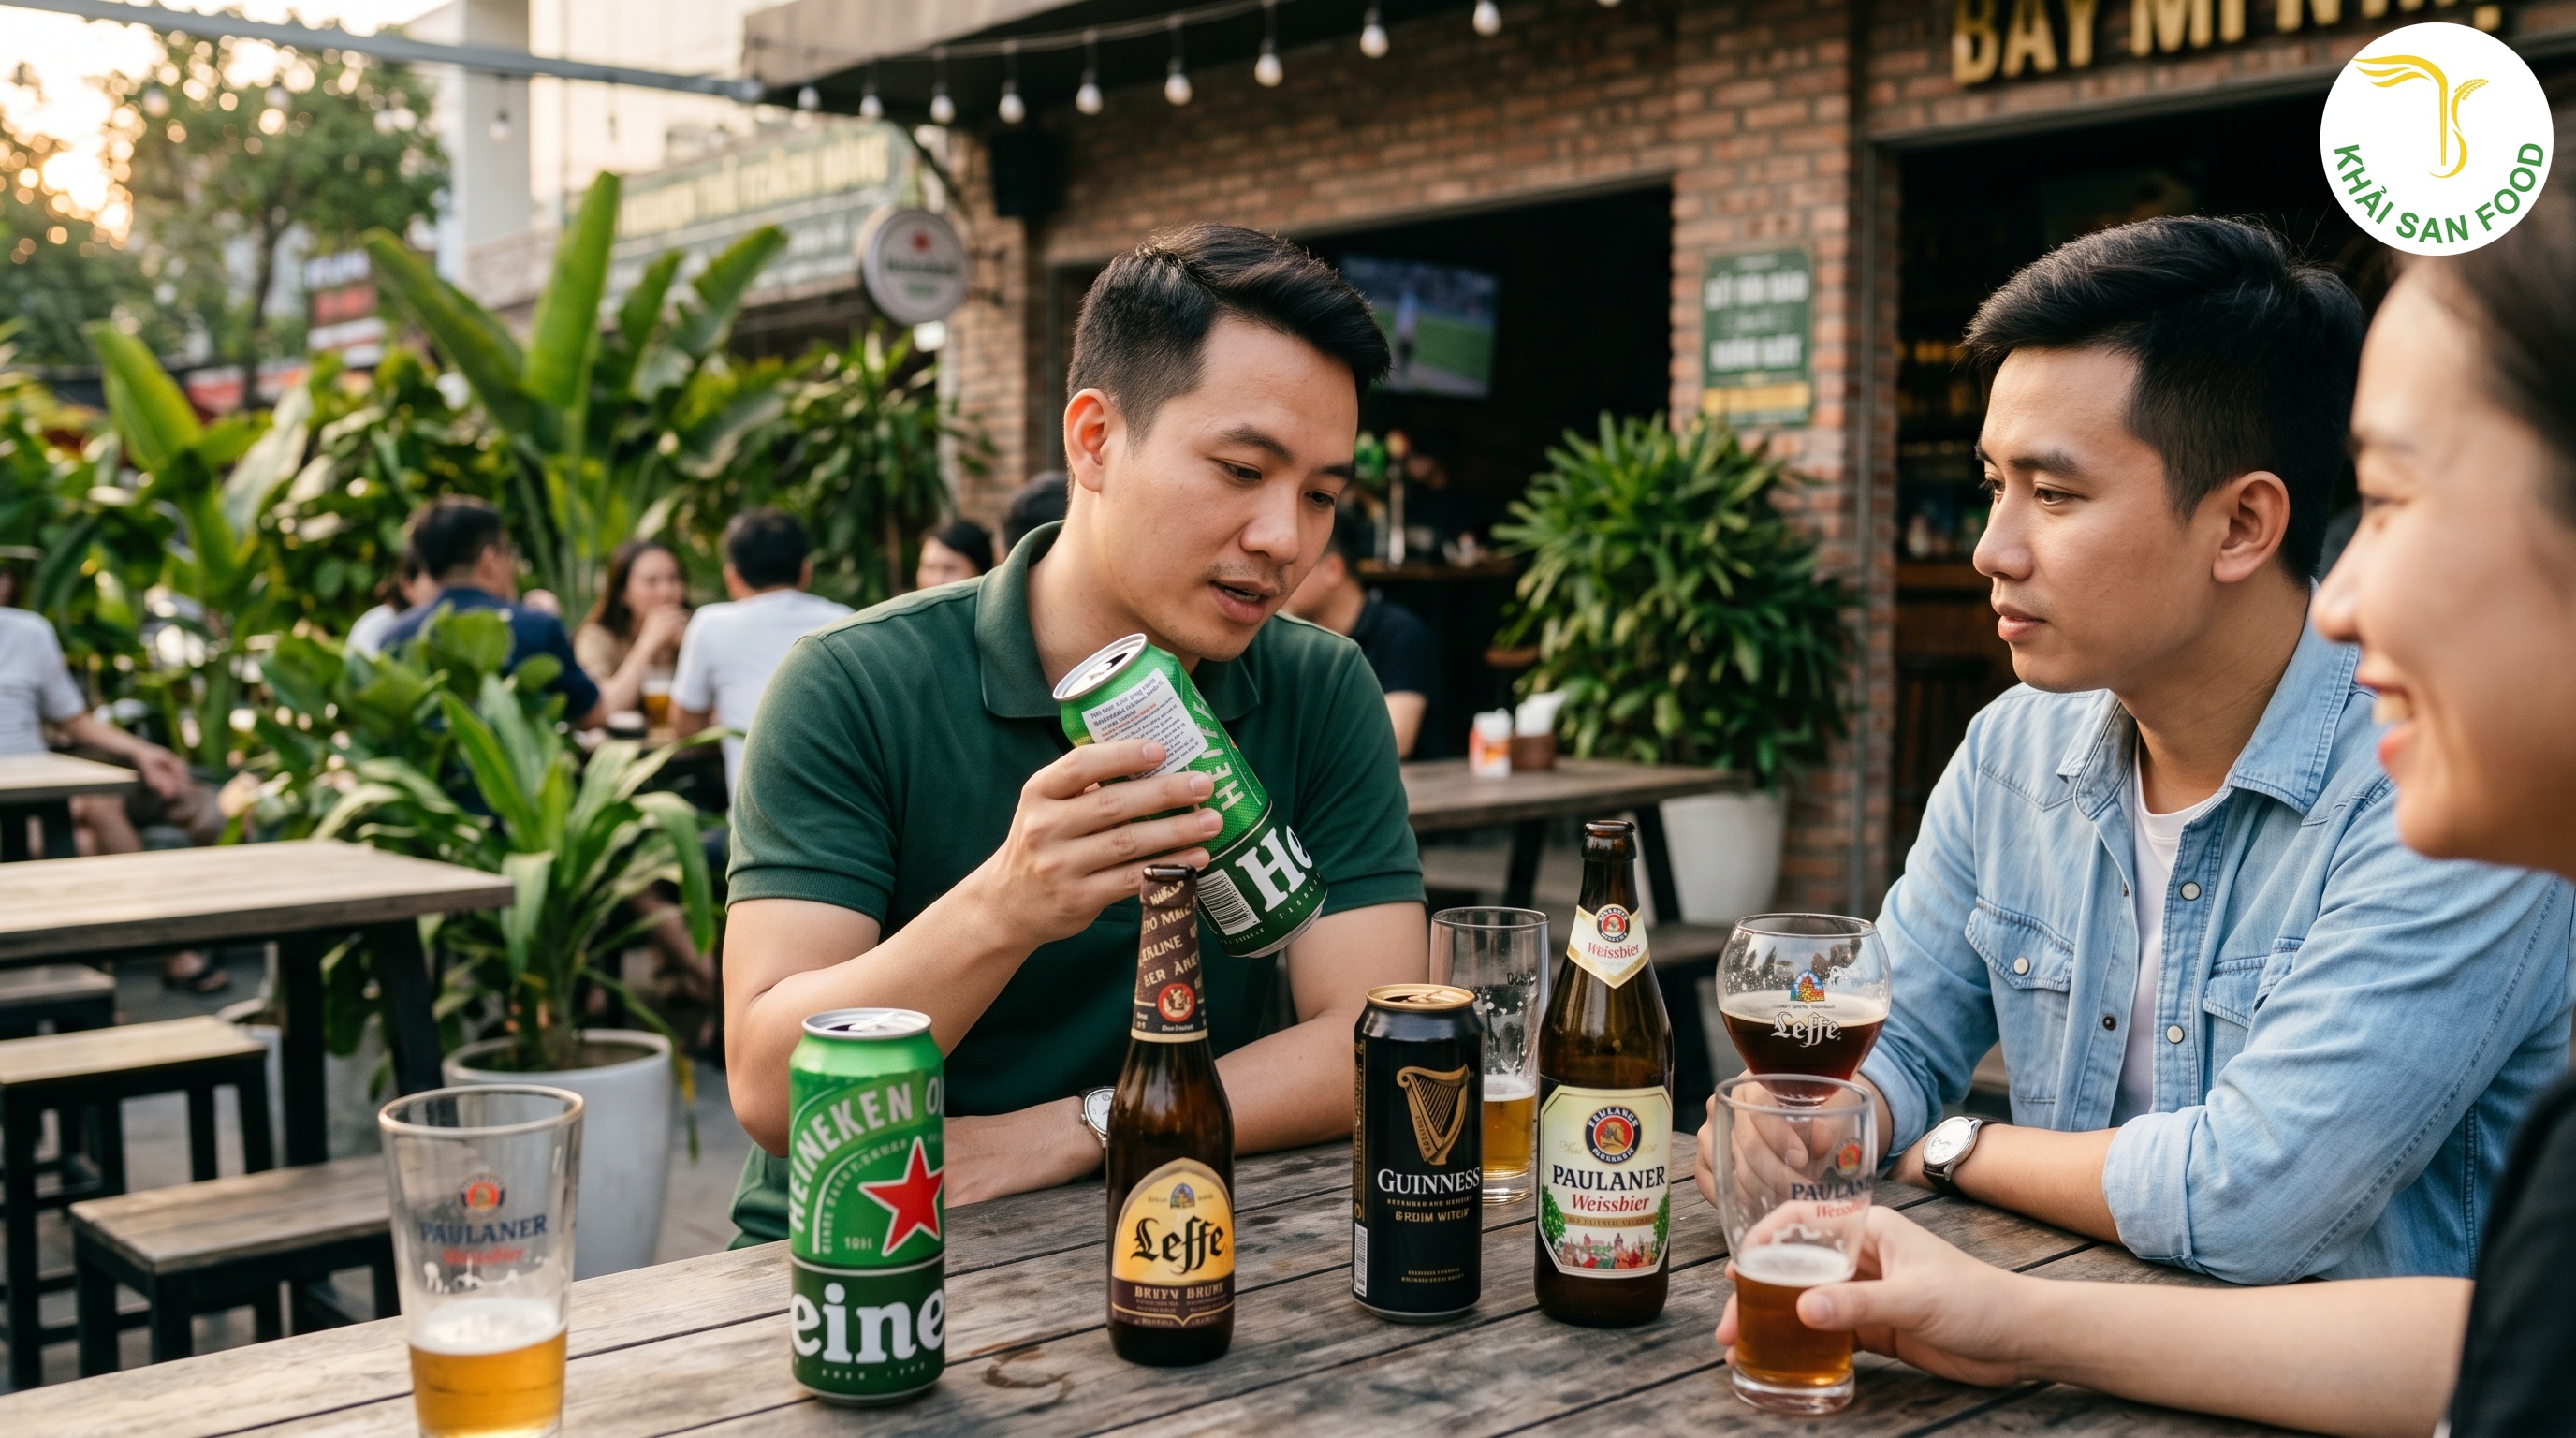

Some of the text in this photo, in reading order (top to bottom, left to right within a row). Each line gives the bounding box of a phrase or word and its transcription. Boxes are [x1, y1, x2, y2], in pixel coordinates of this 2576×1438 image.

[1588, 942, 1639, 959] Weissbier
[1771, 1011, 1841, 1048] Leffe
[789, 1081, 913, 1234] HEINEKEN
[1377, 1167, 1480, 1195] GUINNESS
[1553, 1164, 1665, 1191] PAULANER
[1573, 1194, 1649, 1212] Weissbier
[421, 1214, 547, 1245] PAULANER
[1131, 1215, 1226, 1276] Leffe
